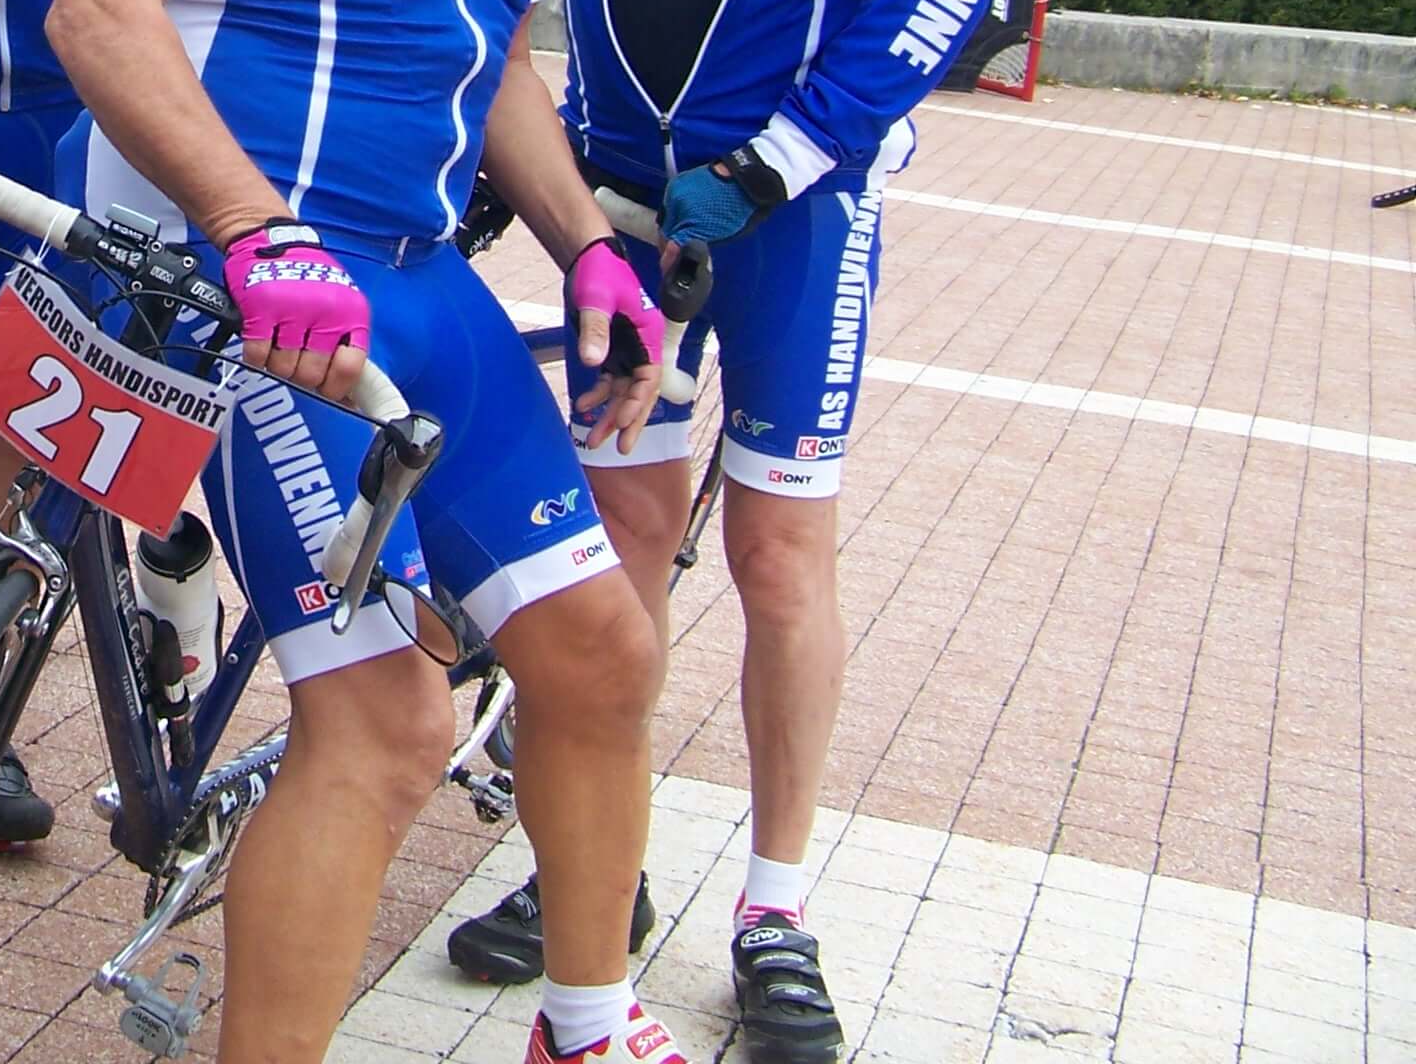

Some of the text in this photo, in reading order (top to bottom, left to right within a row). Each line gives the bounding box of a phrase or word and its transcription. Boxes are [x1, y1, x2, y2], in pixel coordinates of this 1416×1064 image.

[15, 267, 228, 430] VERCORS HANDISPORT
[6, 353, 145, 496] 21
[818, 391, 849, 430] AS
[769, 470, 813, 485] KONY
